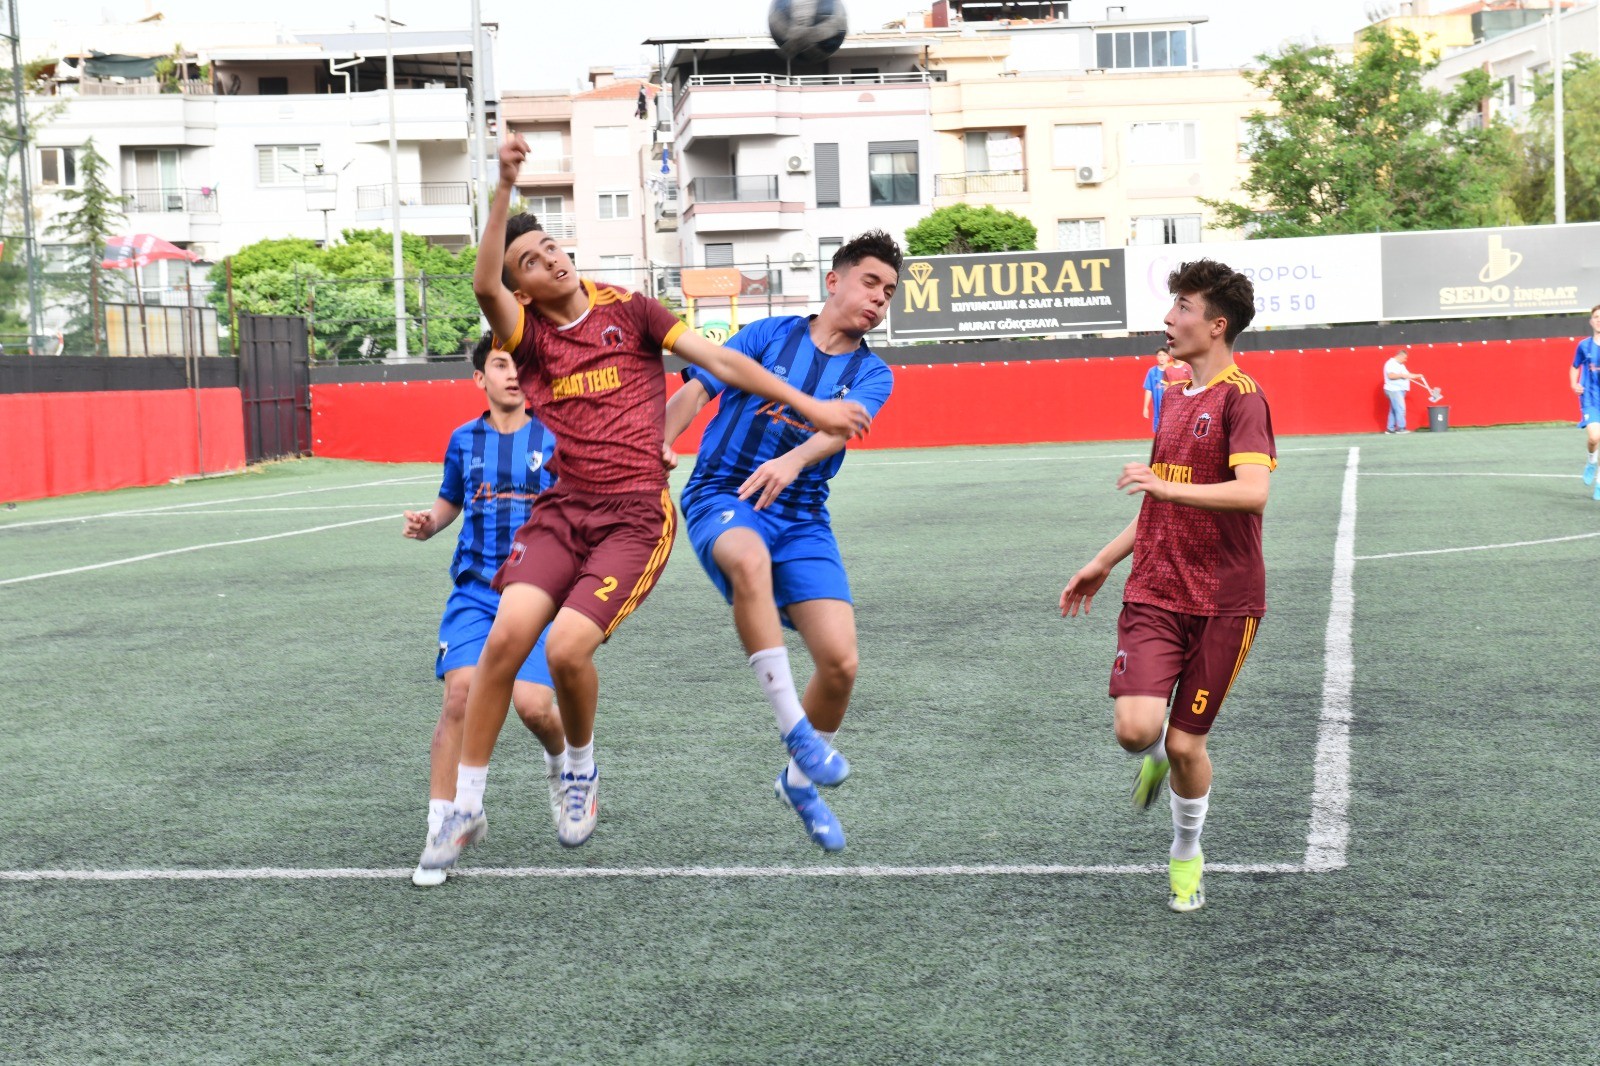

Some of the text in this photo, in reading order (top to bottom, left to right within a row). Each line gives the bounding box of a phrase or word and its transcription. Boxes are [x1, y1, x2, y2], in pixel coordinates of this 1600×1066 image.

[950, 258, 1111, 298] MURAT
[1232, 265, 1322, 283] ROPOL
[1019, 299, 1027, 309] &
[1028, 298, 1053, 309] SAAT
[1054, 297, 1062, 307] &
[1063, 295, 1112, 307] PIRLANTA
[1255, 294, 1316, 312] 35 50
[1439, 285, 1510, 304] SEDO
[958, 317, 1059, 332] MURAT GÖKÇEKAYA
[585, 366, 621, 393] TEKEL
[594, 576, 618, 602] 2
[1191, 689, 1209, 714] 5
